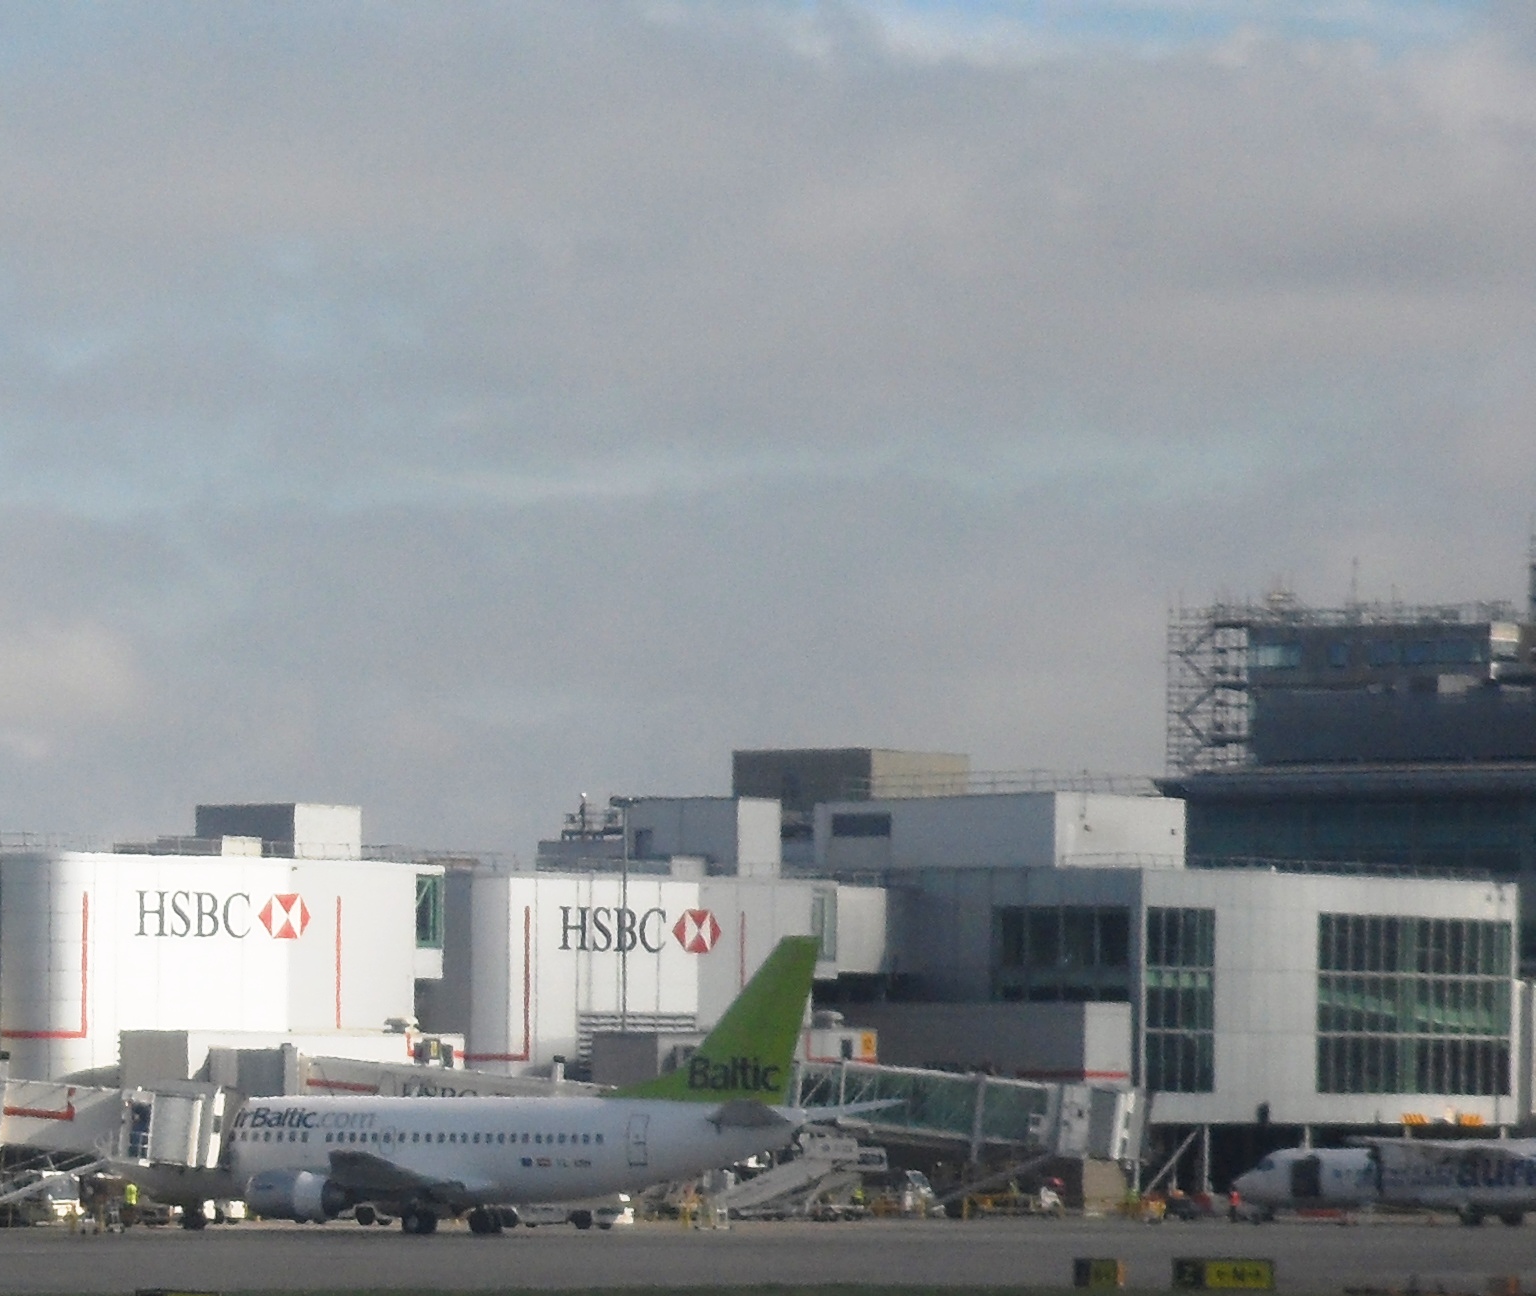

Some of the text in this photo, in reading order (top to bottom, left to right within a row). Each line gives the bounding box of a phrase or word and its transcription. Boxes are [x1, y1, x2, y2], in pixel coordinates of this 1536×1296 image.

[134, 890, 251, 939] HSBC
[558, 905, 667, 953] HSBC
[688, 1056, 781, 1092] Baltic
[233, 1107, 378, 1129] irBaltic.com
